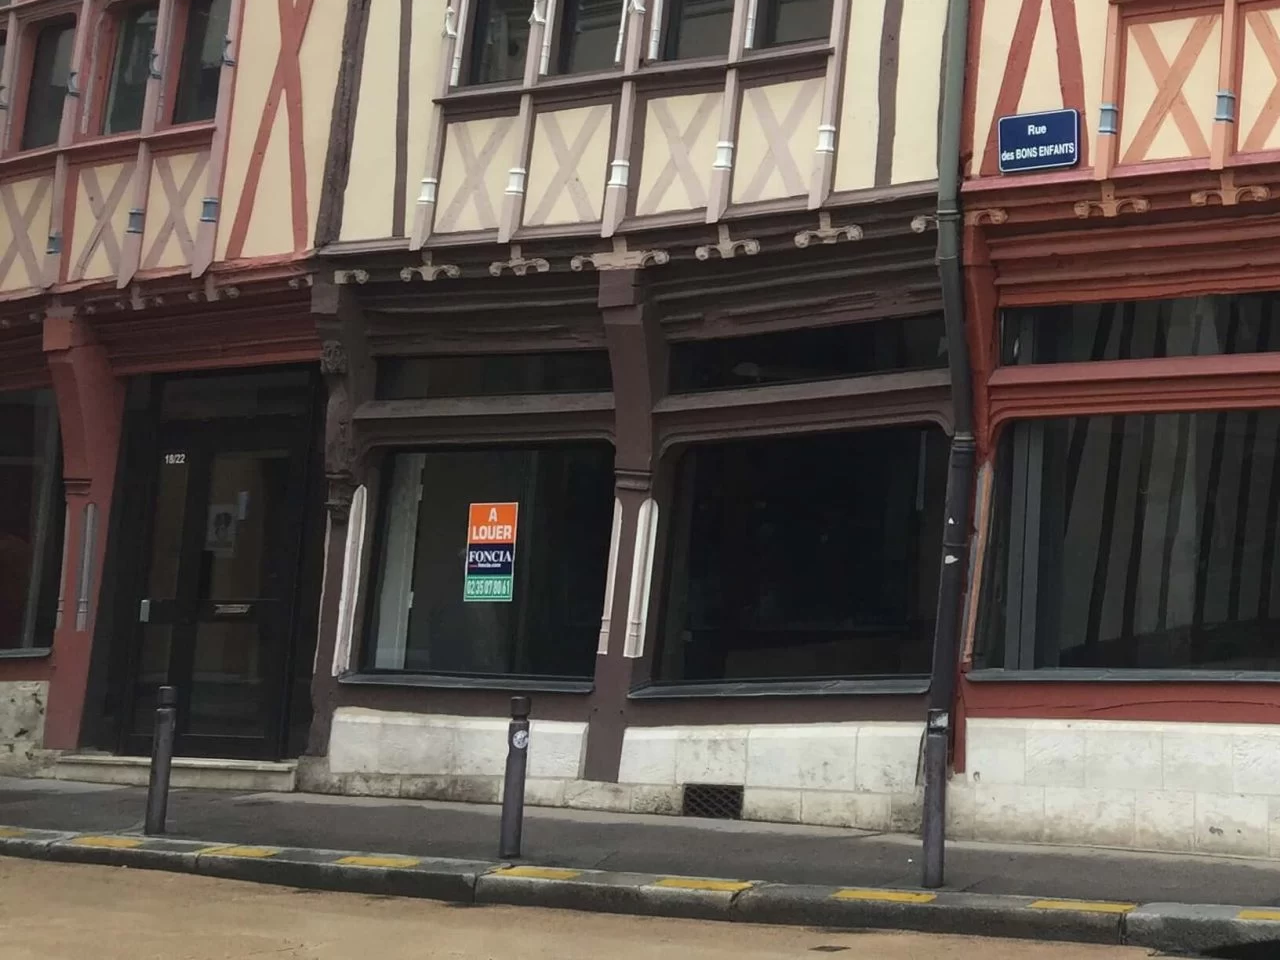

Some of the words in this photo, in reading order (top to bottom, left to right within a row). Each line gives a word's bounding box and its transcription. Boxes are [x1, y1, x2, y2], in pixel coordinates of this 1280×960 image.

[1027, 124, 1047, 135] Rue
[1001, 150, 1015, 161] des
[1015, 146, 1038, 160] BONS
[1038, 142, 1075, 157] ENFANTS
[165, 453, 186, 464] 18/22
[488, 507, 498, 522] A
[472, 524, 513, 540] LOUER
[469, 550, 512, 562] FONCIA
